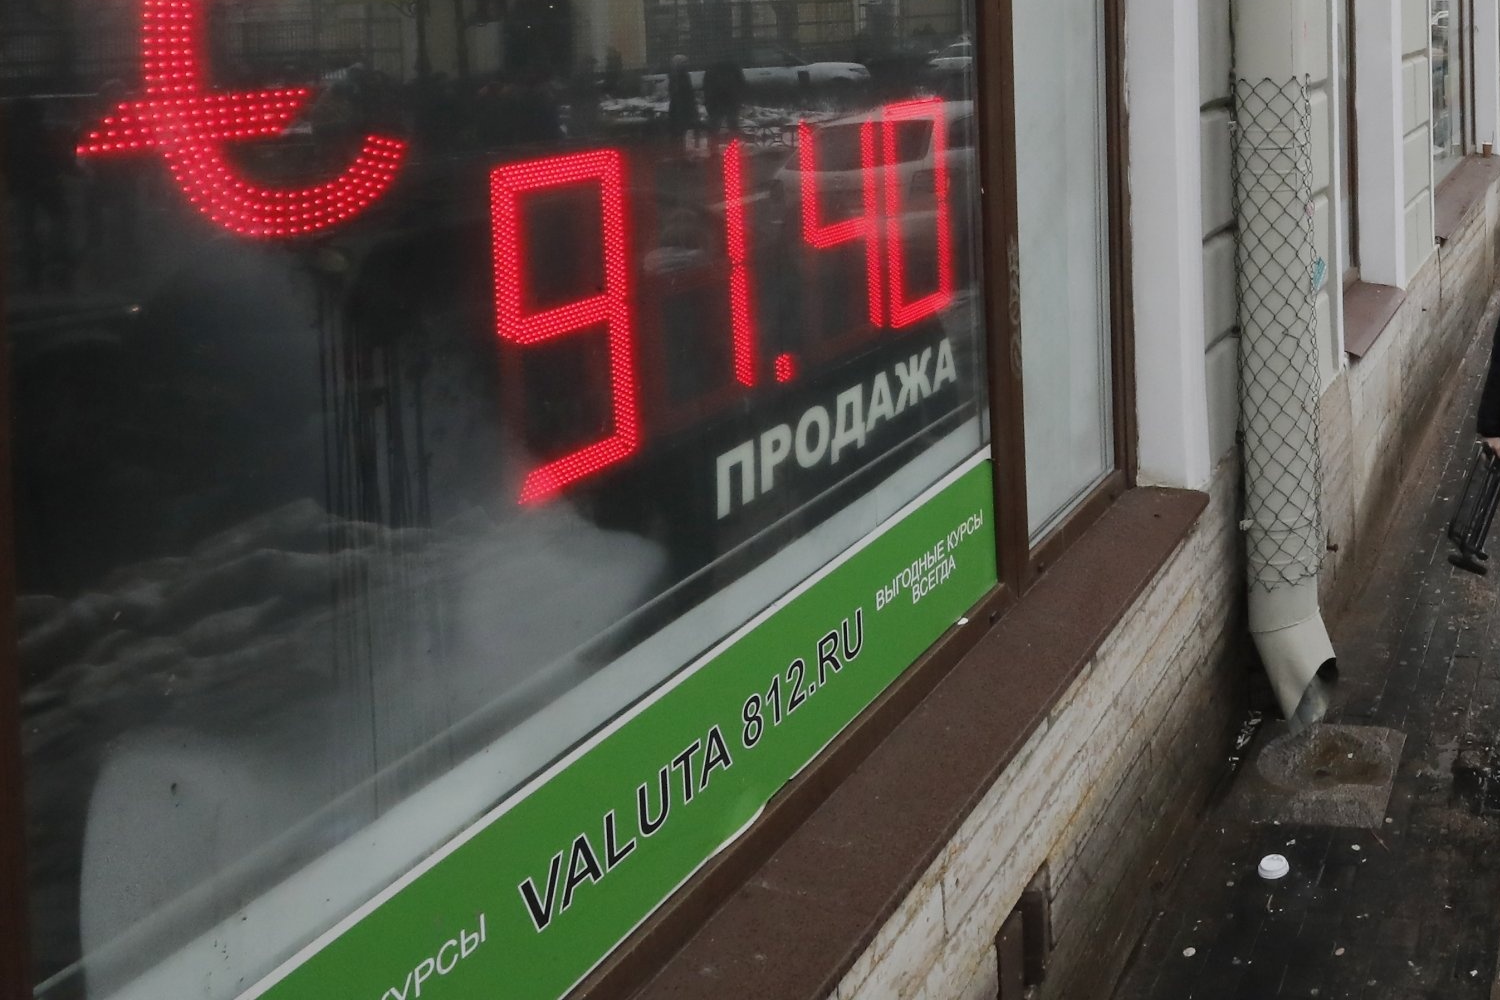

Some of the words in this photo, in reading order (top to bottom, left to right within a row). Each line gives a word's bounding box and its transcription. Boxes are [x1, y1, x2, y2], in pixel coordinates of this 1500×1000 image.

[490, 98, 952, 504] 91.40
[716, 338, 958, 520] ПРОДАЖА
[875, 539, 945, 611] ВЫГОДНЫЕ
[946, 508, 983, 552] КУРСЫ
[912, 554, 956, 604] ВСЕГДА
[517, 724, 733, 934] VALUTA
[741, 606, 864, 749] 812.RU
[381, 912, 486, 1000] УРСЫ
